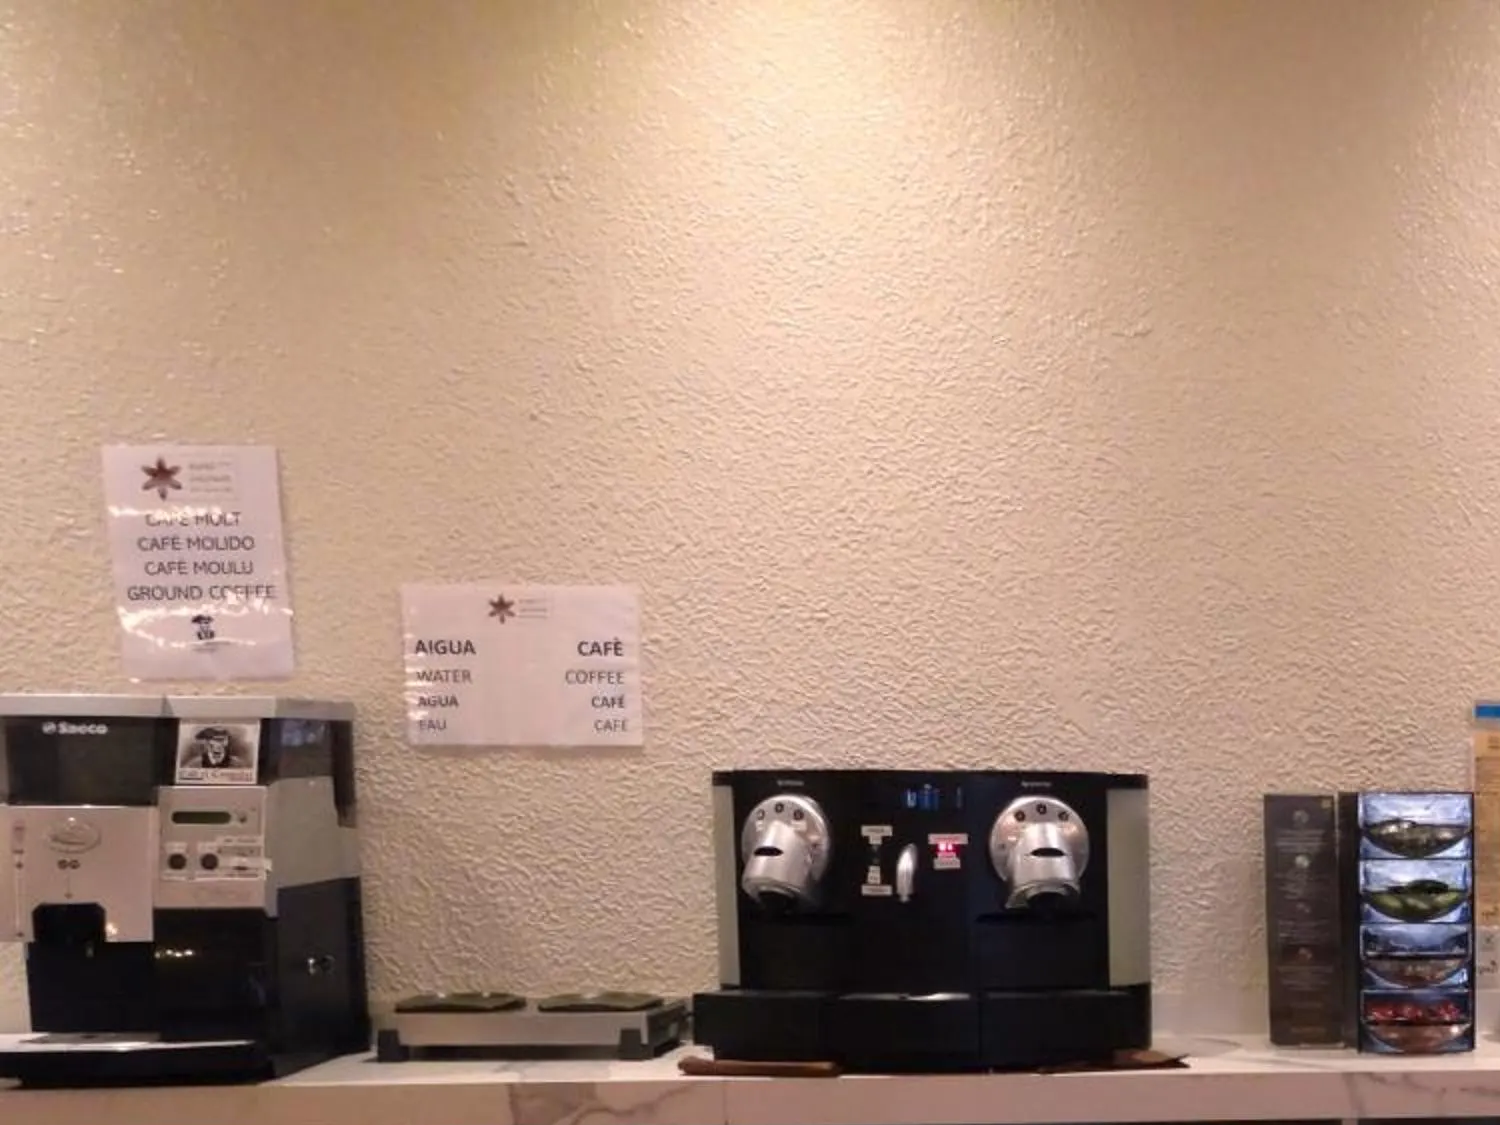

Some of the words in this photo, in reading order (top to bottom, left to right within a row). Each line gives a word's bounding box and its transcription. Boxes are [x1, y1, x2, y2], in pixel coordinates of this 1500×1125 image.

[186, 535, 256, 551] MOLIDO
[193, 559, 254, 576] MOULU
[126, 584, 203, 601] GROUND
[414, 638, 477, 656] AIGUA
[416, 668, 473, 684] WATER
[564, 669, 625, 686] COFFEE
[417, 695, 460, 709] AGUA
[418, 718, 448, 731] EAU
